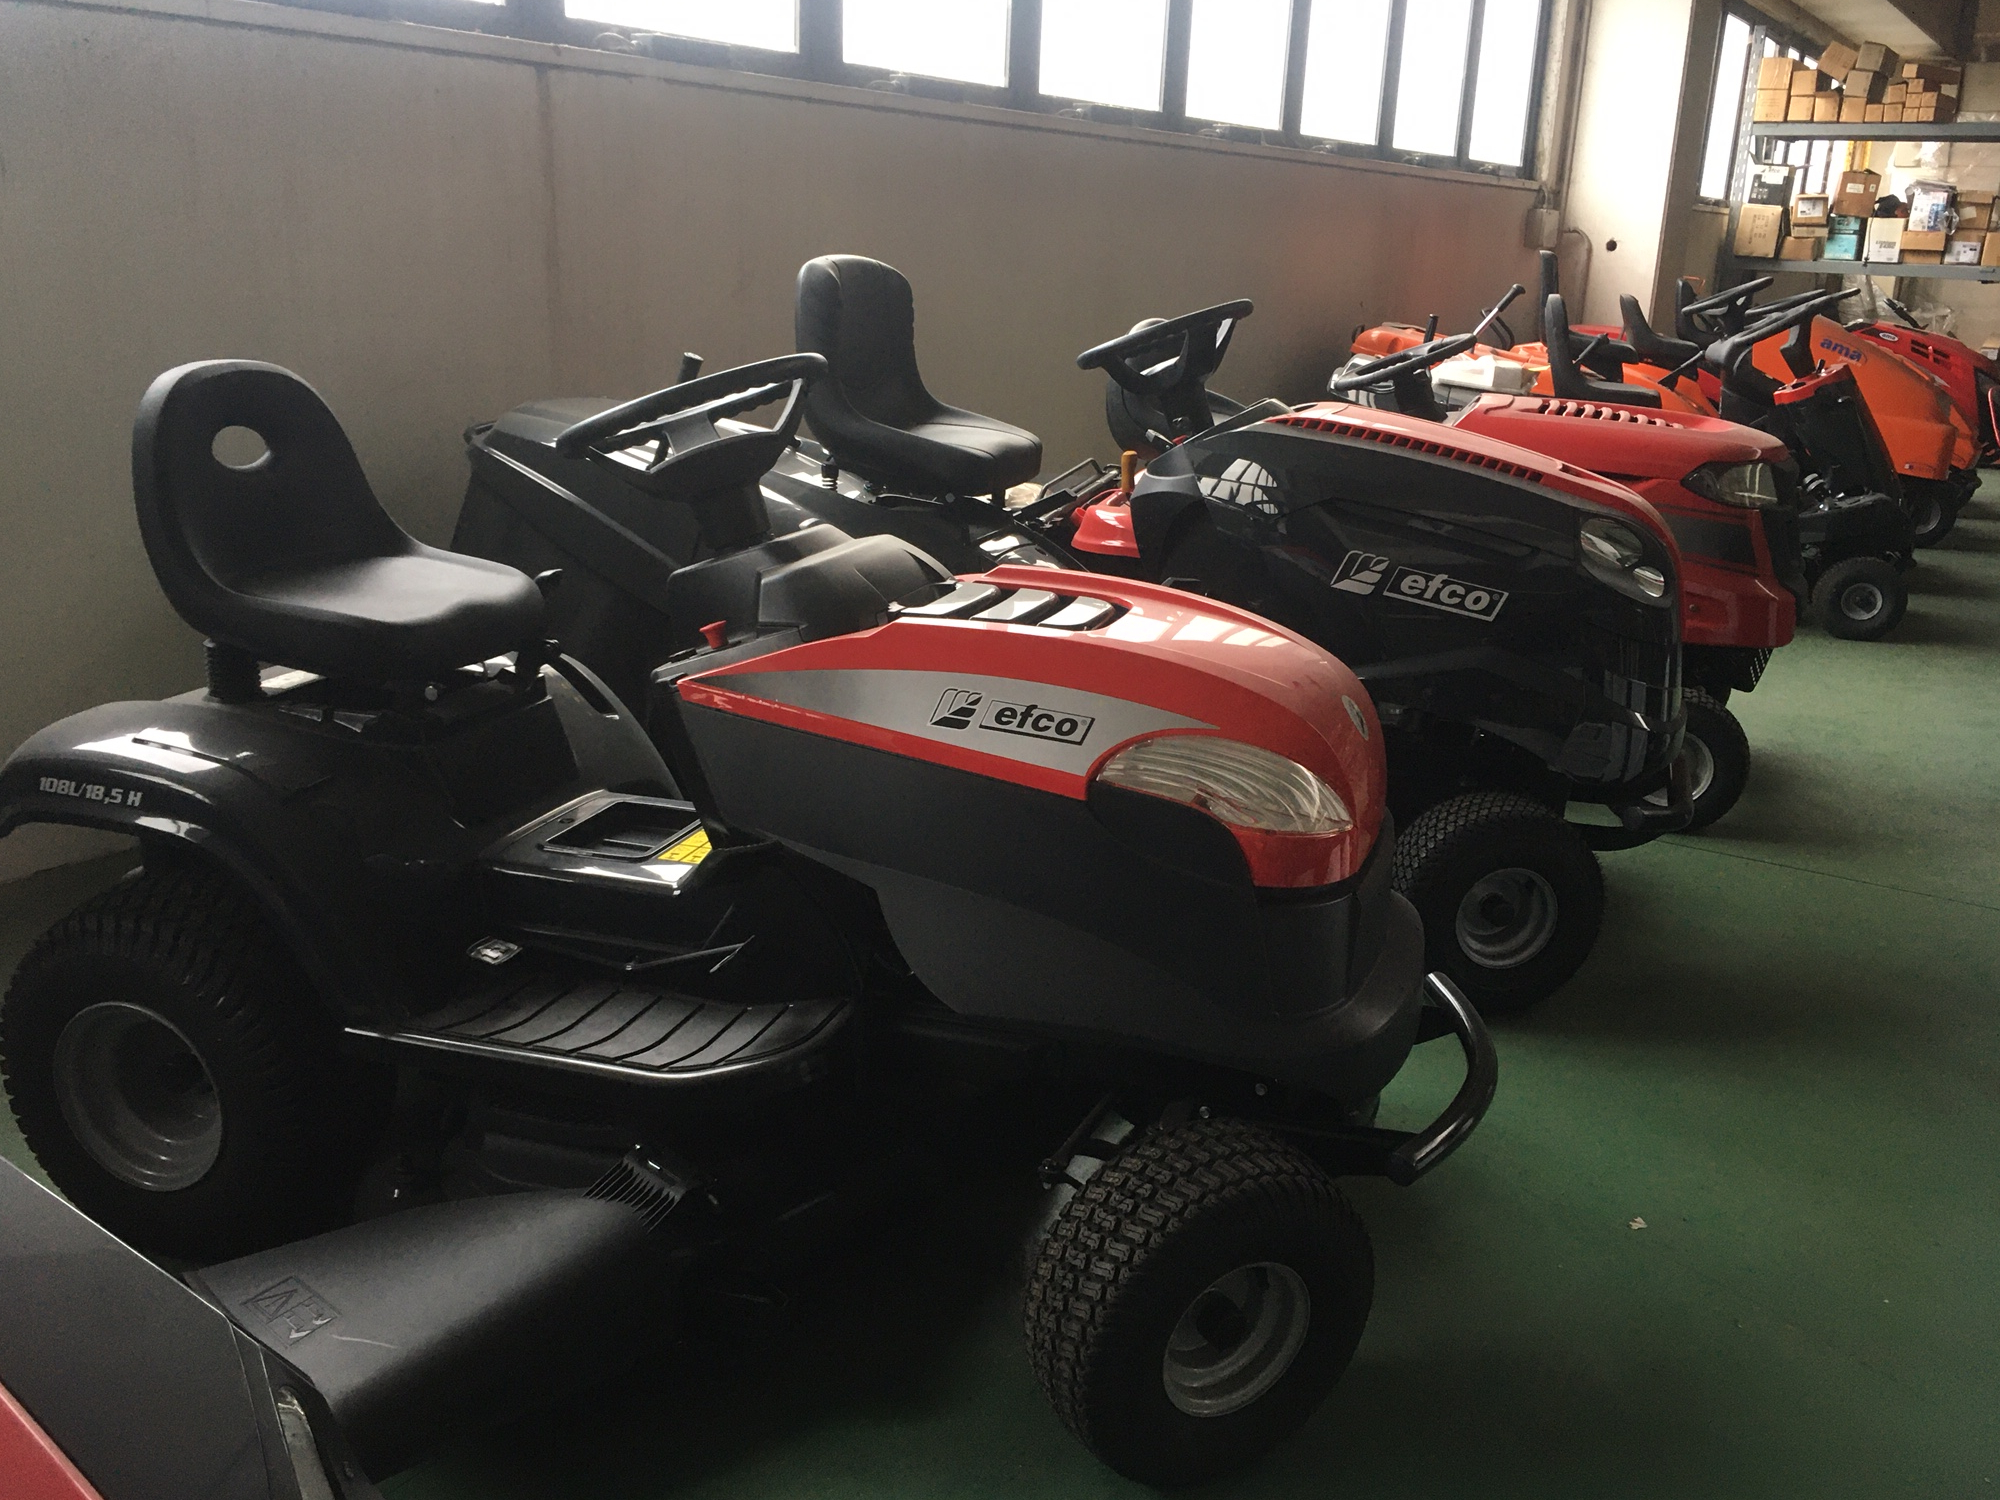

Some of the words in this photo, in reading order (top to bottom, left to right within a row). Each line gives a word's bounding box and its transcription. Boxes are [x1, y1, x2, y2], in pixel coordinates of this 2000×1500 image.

[1820, 338, 1862, 361] ama
[1400, 574, 1490, 611] efco
[994, 704, 1079, 736] efco
[39, 776, 124, 804] 108L/18,5
[127, 790, 143, 807] H
